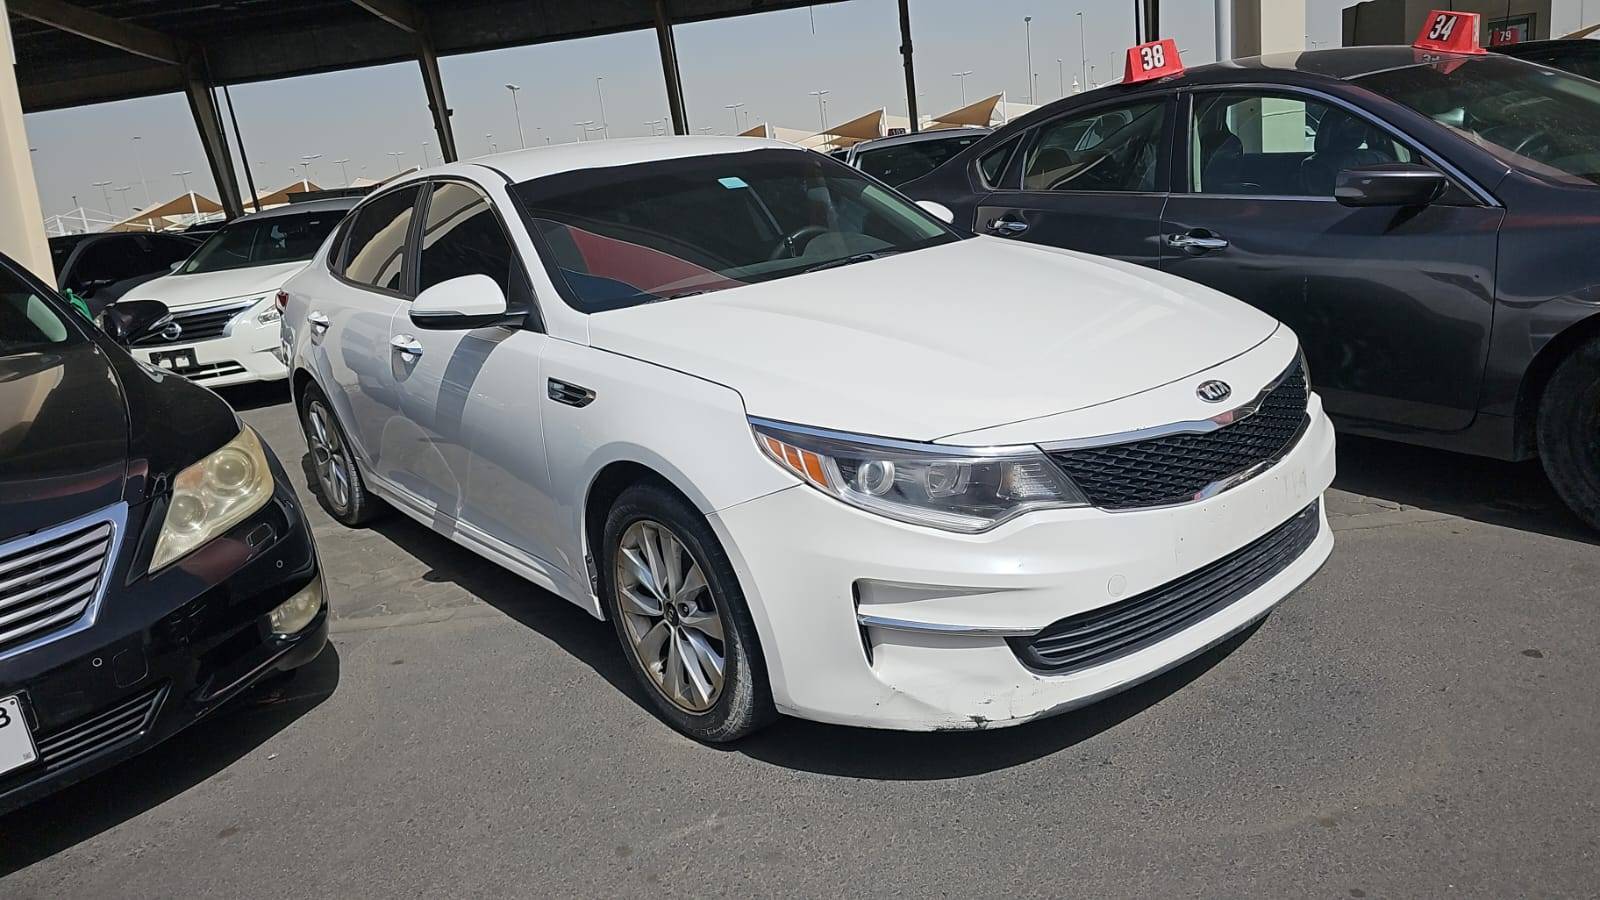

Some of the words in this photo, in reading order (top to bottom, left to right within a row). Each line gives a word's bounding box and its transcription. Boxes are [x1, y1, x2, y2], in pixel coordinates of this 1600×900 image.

[1429, 14, 1457, 41] 34
[1500, 30, 1511, 42] 79
[1141, 44, 1165, 70] 38
[1202, 381, 1230, 399] KIA
